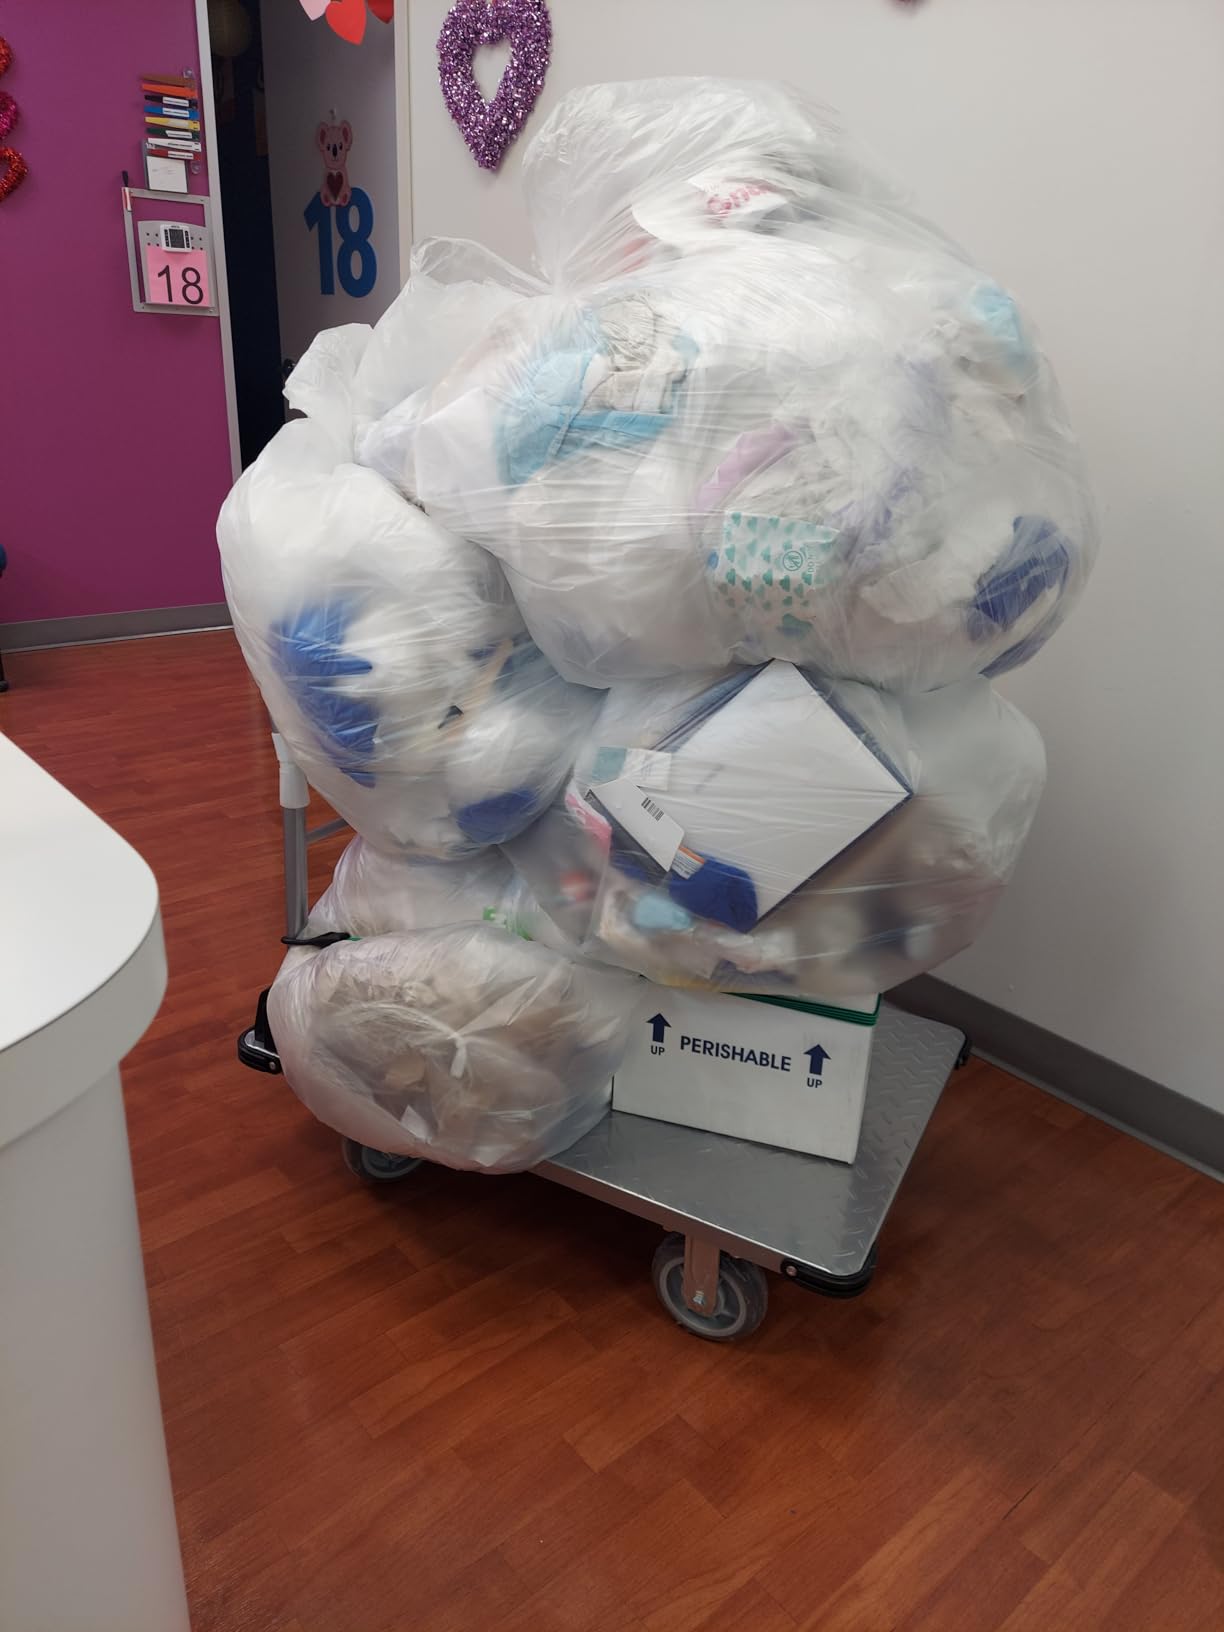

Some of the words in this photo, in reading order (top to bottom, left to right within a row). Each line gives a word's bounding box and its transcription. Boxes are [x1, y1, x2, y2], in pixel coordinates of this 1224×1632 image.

[304, 187, 377, 298] 18
[158, 265, 204, 305] 18
[650, 1045, 665, 1056] UP
[680, 1035, 792, 1072] PERISHABLE
[806, 1077, 823, 1089] UP
